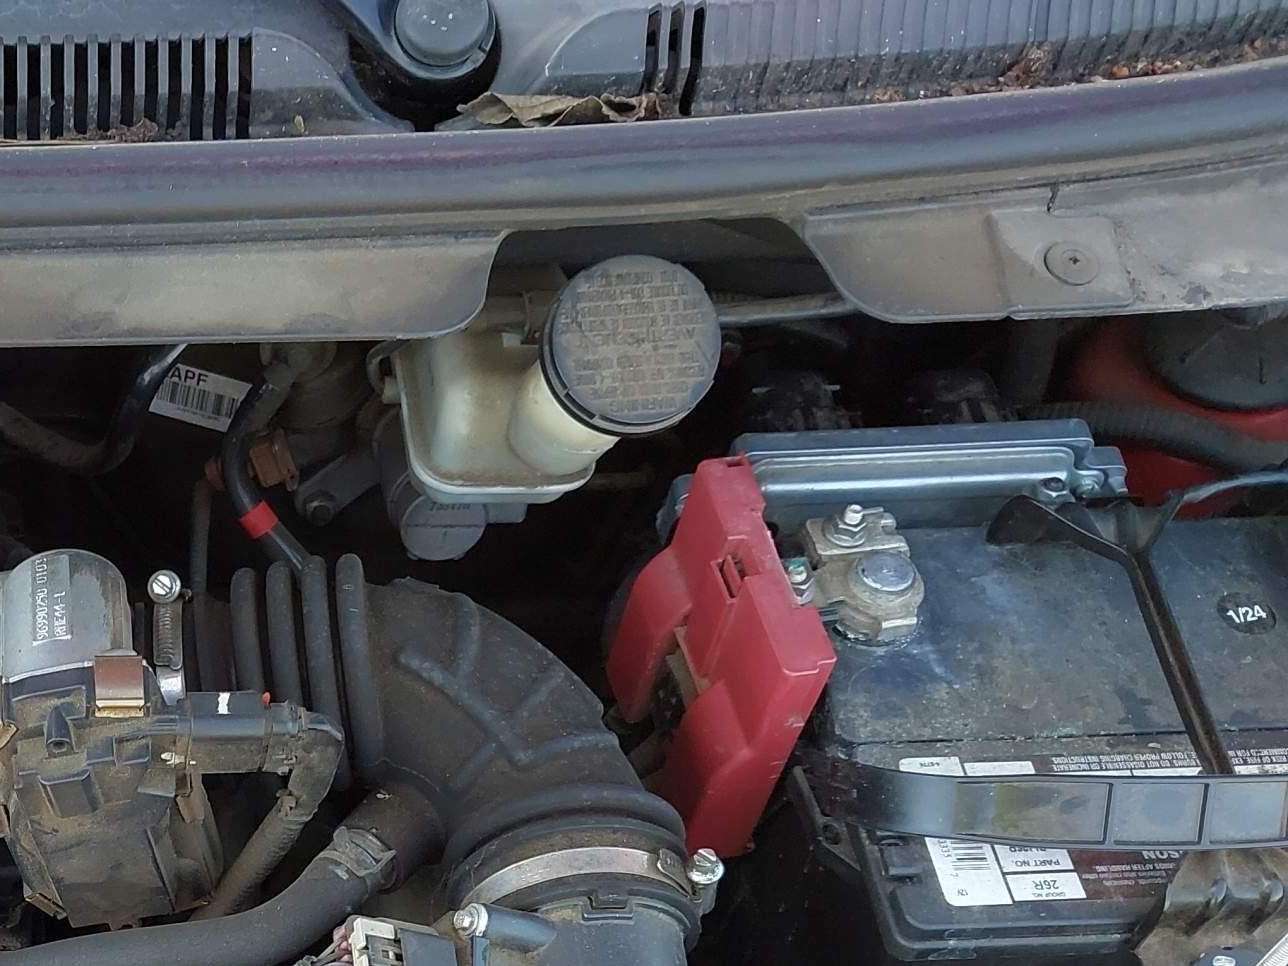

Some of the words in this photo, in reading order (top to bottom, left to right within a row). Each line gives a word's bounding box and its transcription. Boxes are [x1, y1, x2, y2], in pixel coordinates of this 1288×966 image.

[169, 366, 209, 386] APF
[1226, 604, 1267, 623] 1/24
[1011, 859, 1031, 867] NO.
[1033, 858, 1061, 867] PART
[1131, 863, 1154, 871] AFTER
[1031, 879, 1059, 891] 26R
